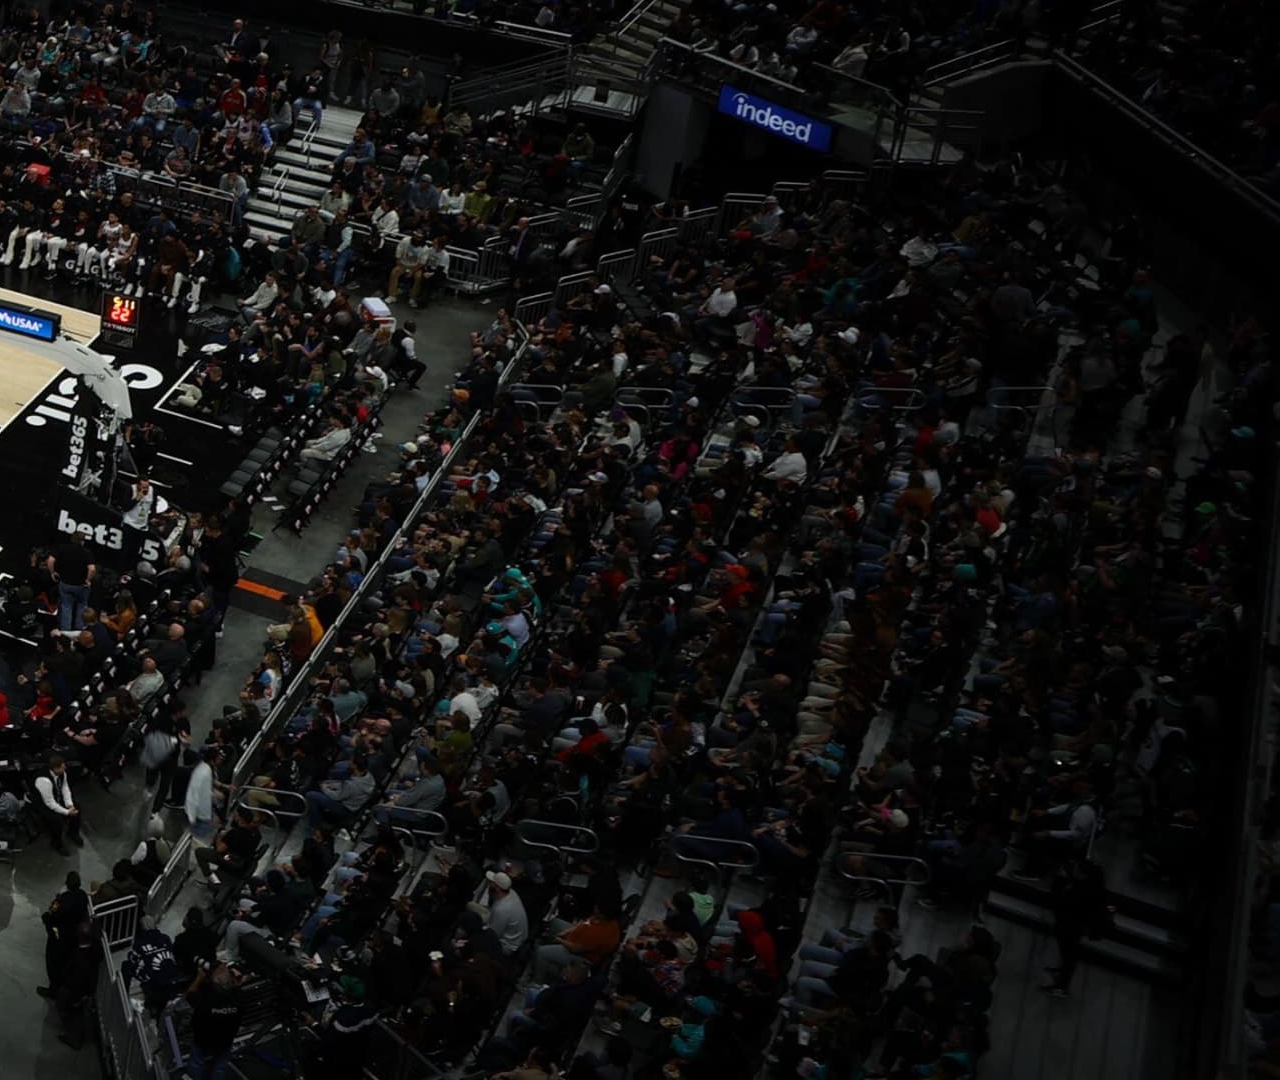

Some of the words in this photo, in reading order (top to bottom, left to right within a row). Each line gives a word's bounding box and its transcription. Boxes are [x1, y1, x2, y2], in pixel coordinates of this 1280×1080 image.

[735, 97, 811, 142] indeed
[12, 317, 39, 332] USAA
[111, 306, 130, 322] 22
[61, 415, 88, 479] bet365
[57, 509, 161, 561] bet35
